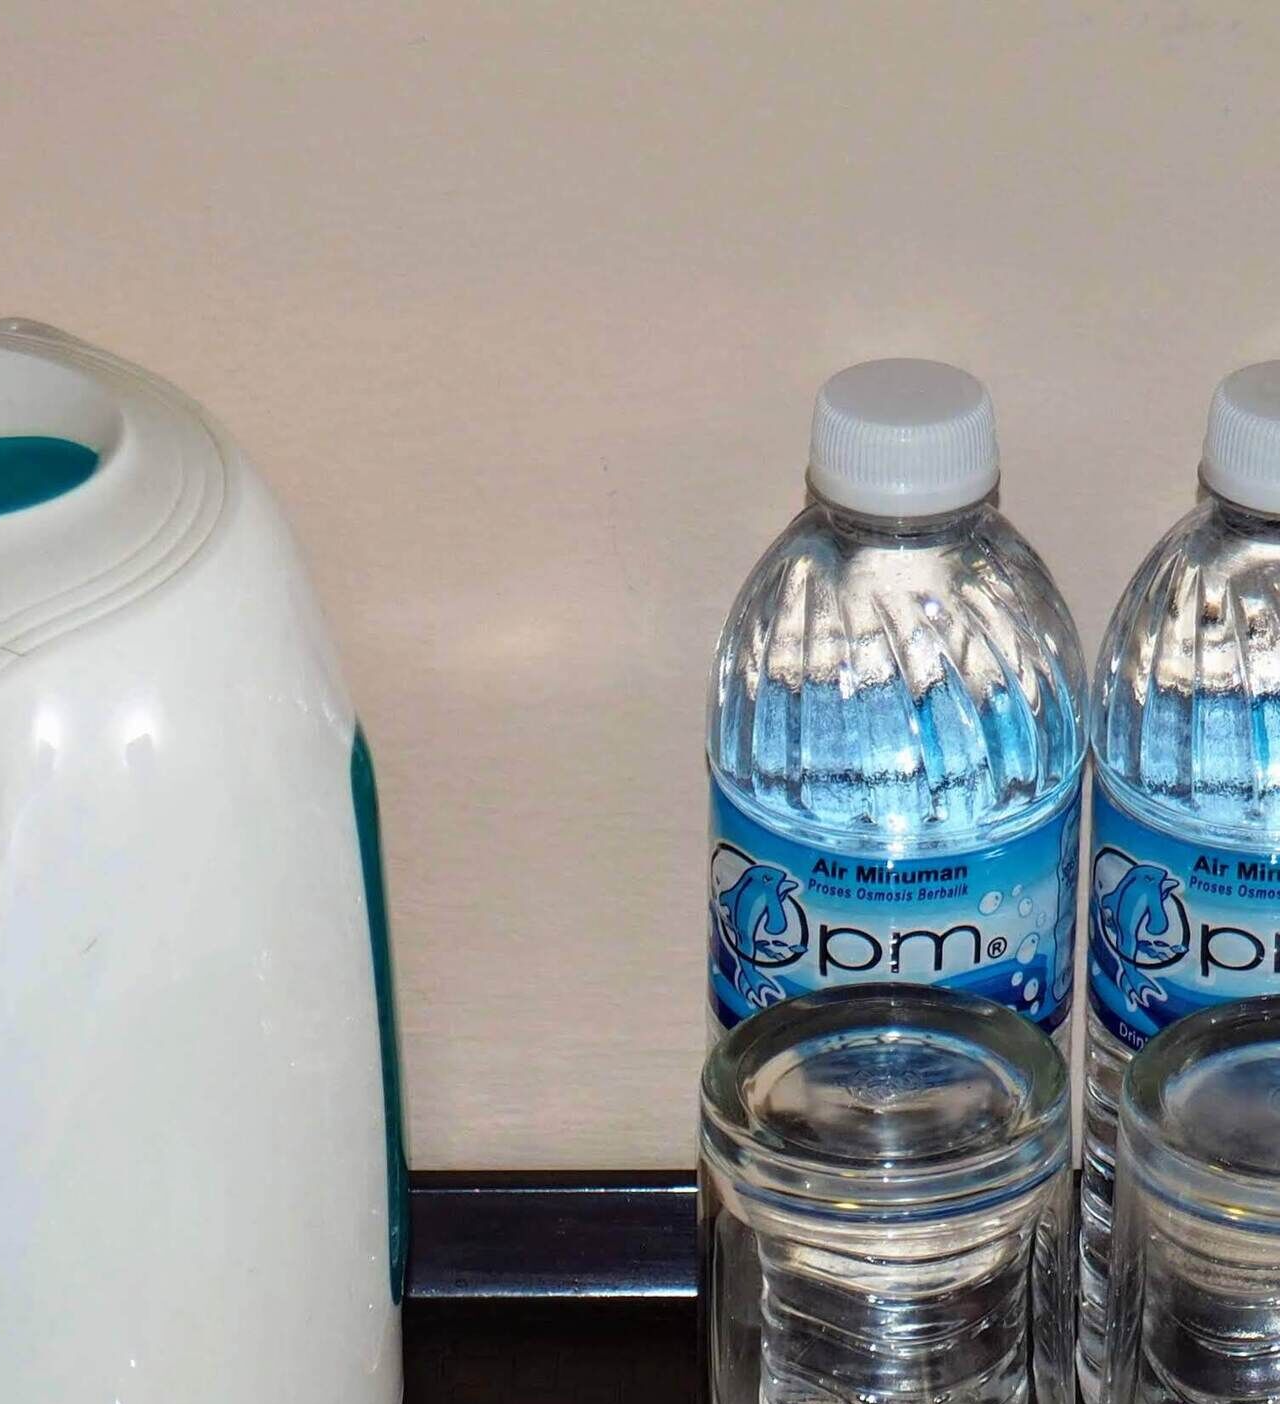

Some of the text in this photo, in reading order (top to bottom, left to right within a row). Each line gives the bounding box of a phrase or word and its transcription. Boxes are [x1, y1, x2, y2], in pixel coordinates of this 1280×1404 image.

[812, 858, 968, 885] Air Minuman
[1193, 855, 1230, 877] Air
[808, 878, 969, 901] Proses Osmosis Berbalik
[1189, 875, 1233, 896] Proses
[1119, 1021, 1150, 1052] Drin
